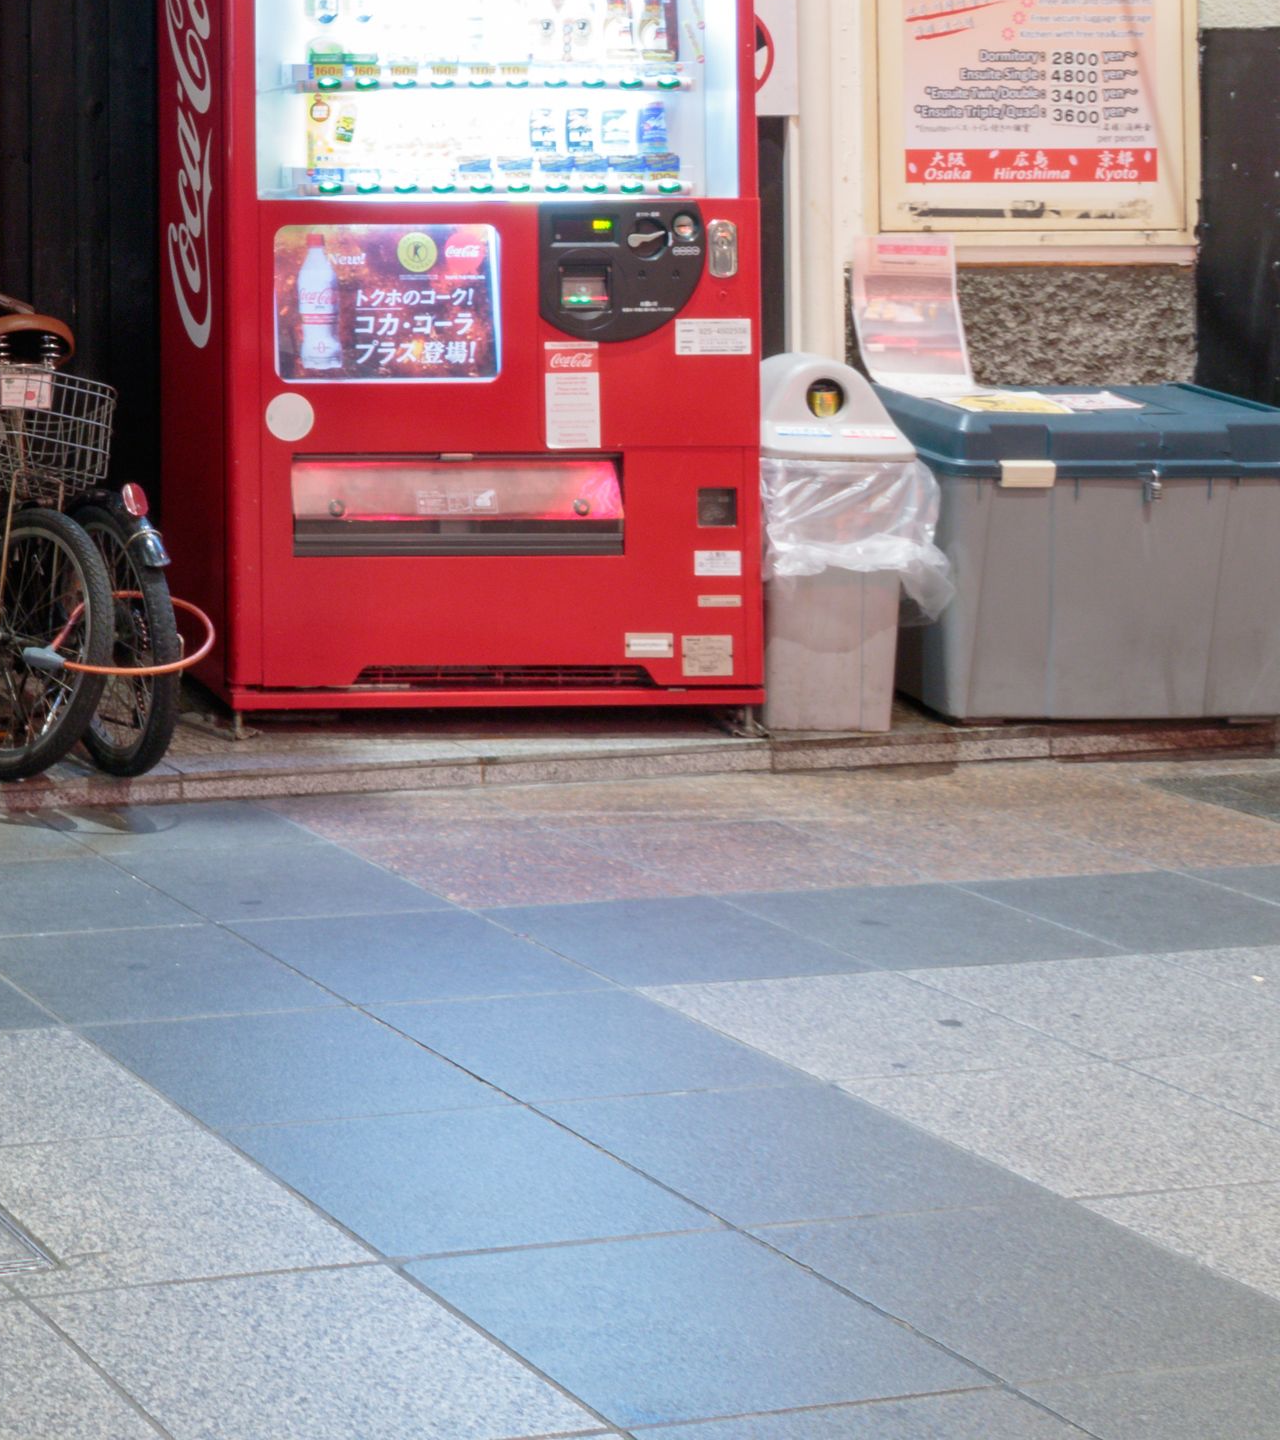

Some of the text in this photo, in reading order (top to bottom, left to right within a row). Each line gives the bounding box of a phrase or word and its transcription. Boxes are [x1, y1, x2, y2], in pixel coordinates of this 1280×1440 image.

[1051, 51, 1099, 67] 2800
[1051, 69, 1098, 84] 4800
[1051, 88, 1098, 105] 3400
[1053, 108, 1100, 124] 3600
[1114, 135, 1146, 144] person
[929, 152, 967, 168] 大阪
[1012, 151, 1049, 167] 広島
[1097, 151, 1136, 168] 京都
[923, 168, 972, 181] Osaka
[993, 167, 1071, 180] Hiroshima
[1095, 167, 1138, 182] Kyoto
[328, 252, 366, 265] New!
[354, 287, 475, 308] トクホのコーク!
[354, 312, 474, 336] コカ・コーラ
